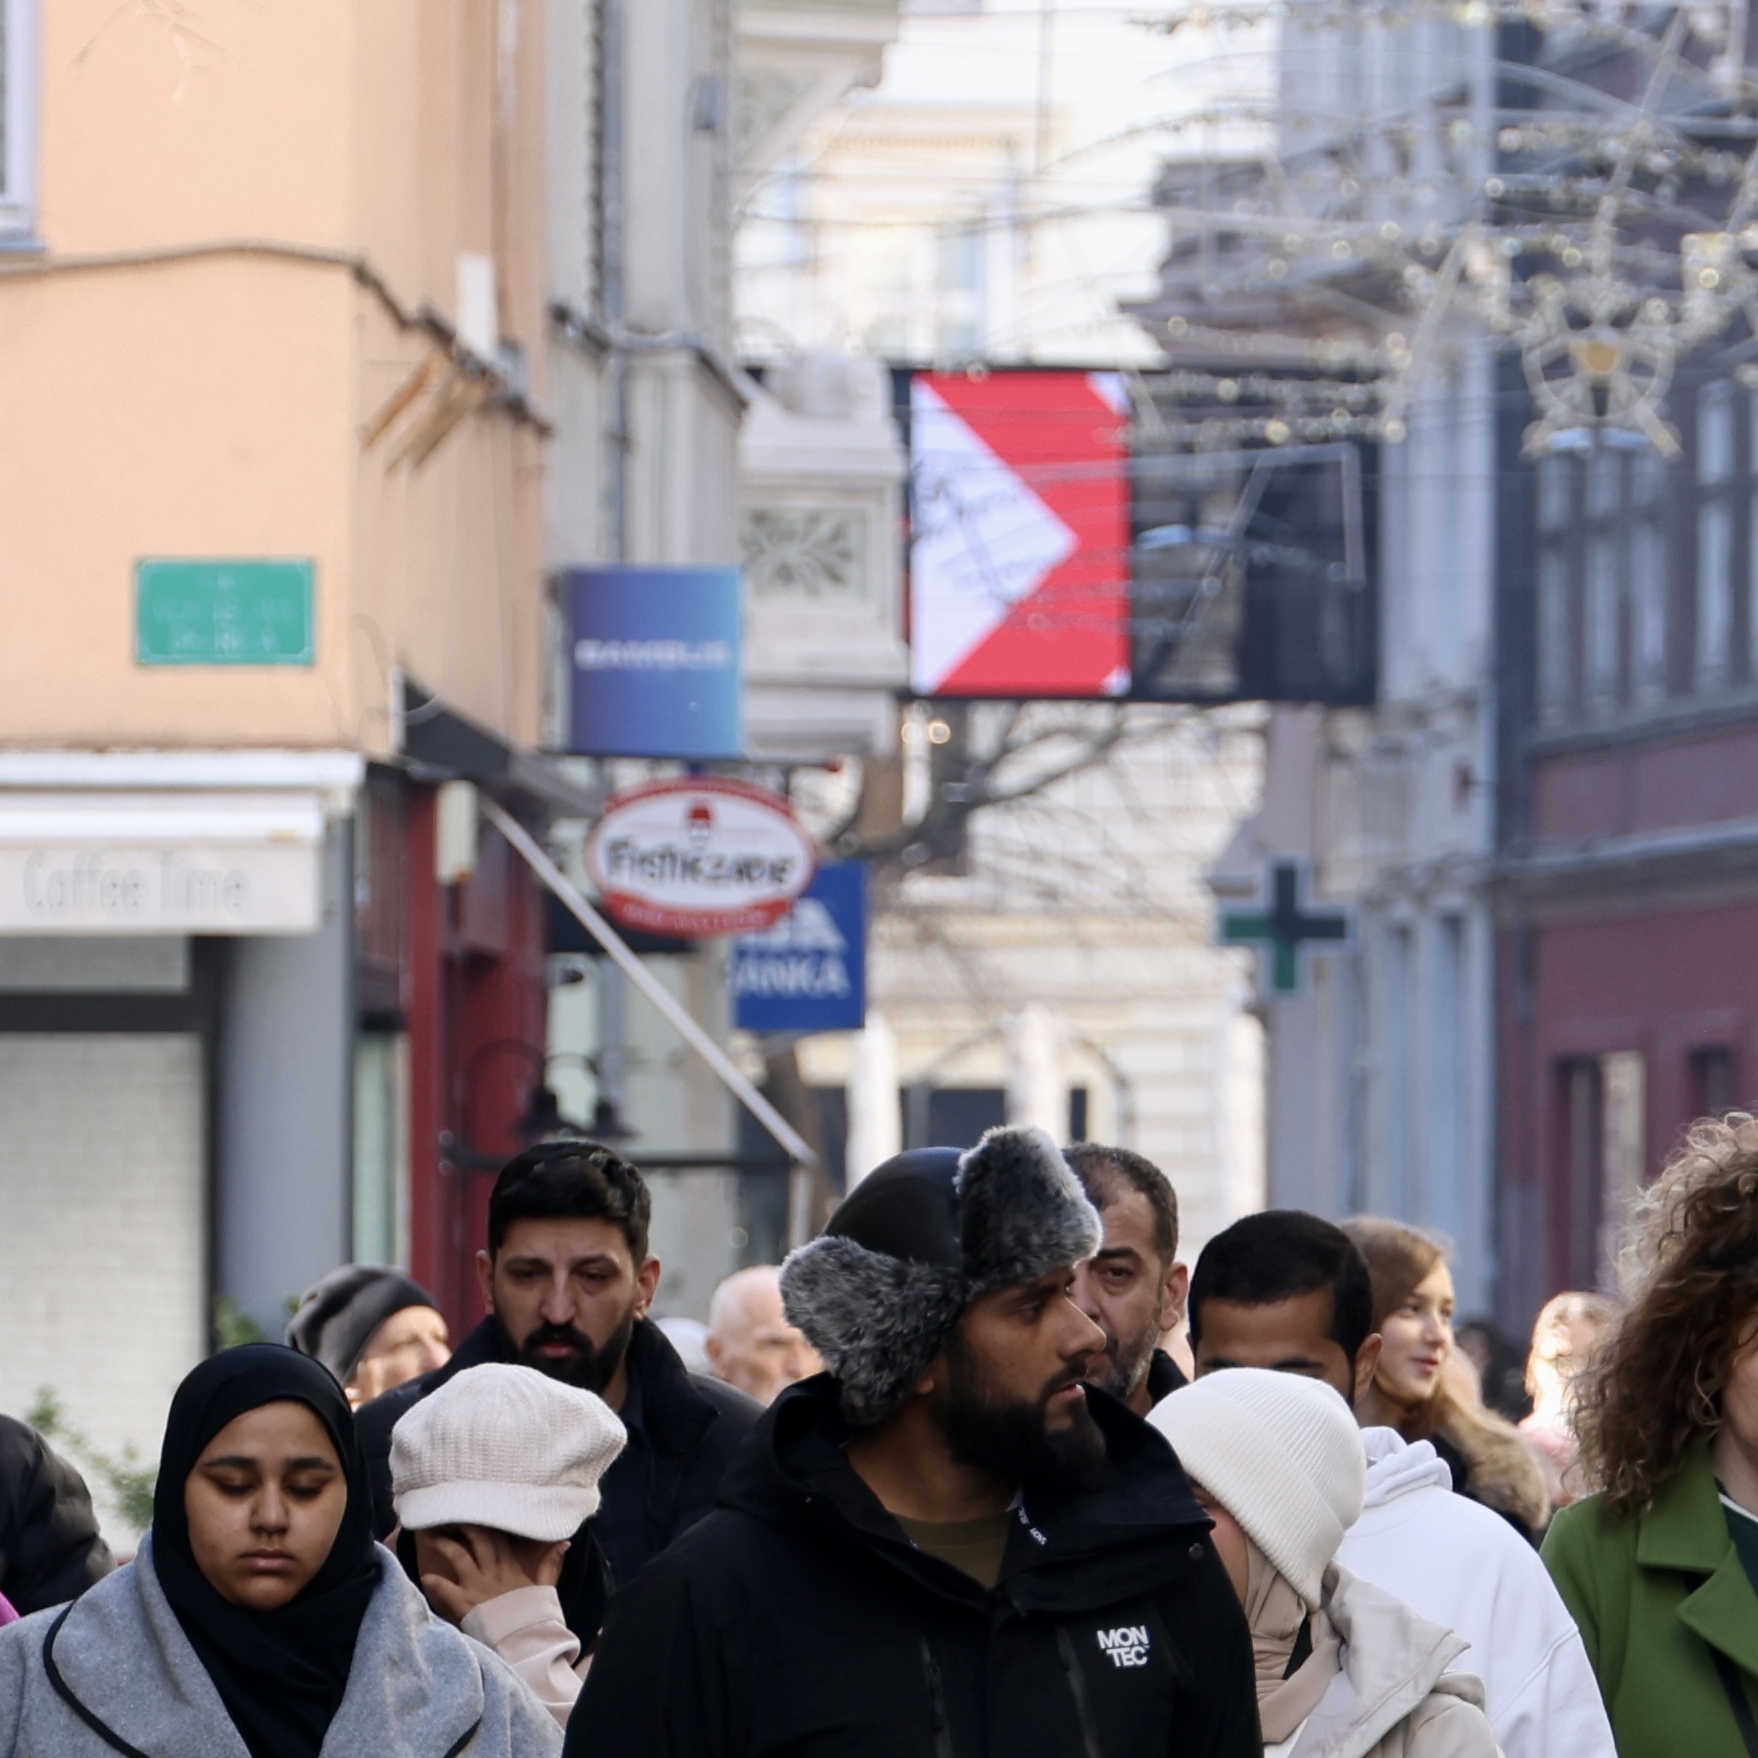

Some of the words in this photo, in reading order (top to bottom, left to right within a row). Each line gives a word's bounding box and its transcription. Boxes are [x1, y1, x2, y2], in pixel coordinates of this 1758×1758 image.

[23, 850, 146, 917] Coffee
[155, 850, 249, 917] Time
[727, 952, 851, 998] ANKA
[1096, 1625, 1149, 1649] MON
[1106, 1645, 1148, 1667] TEC
